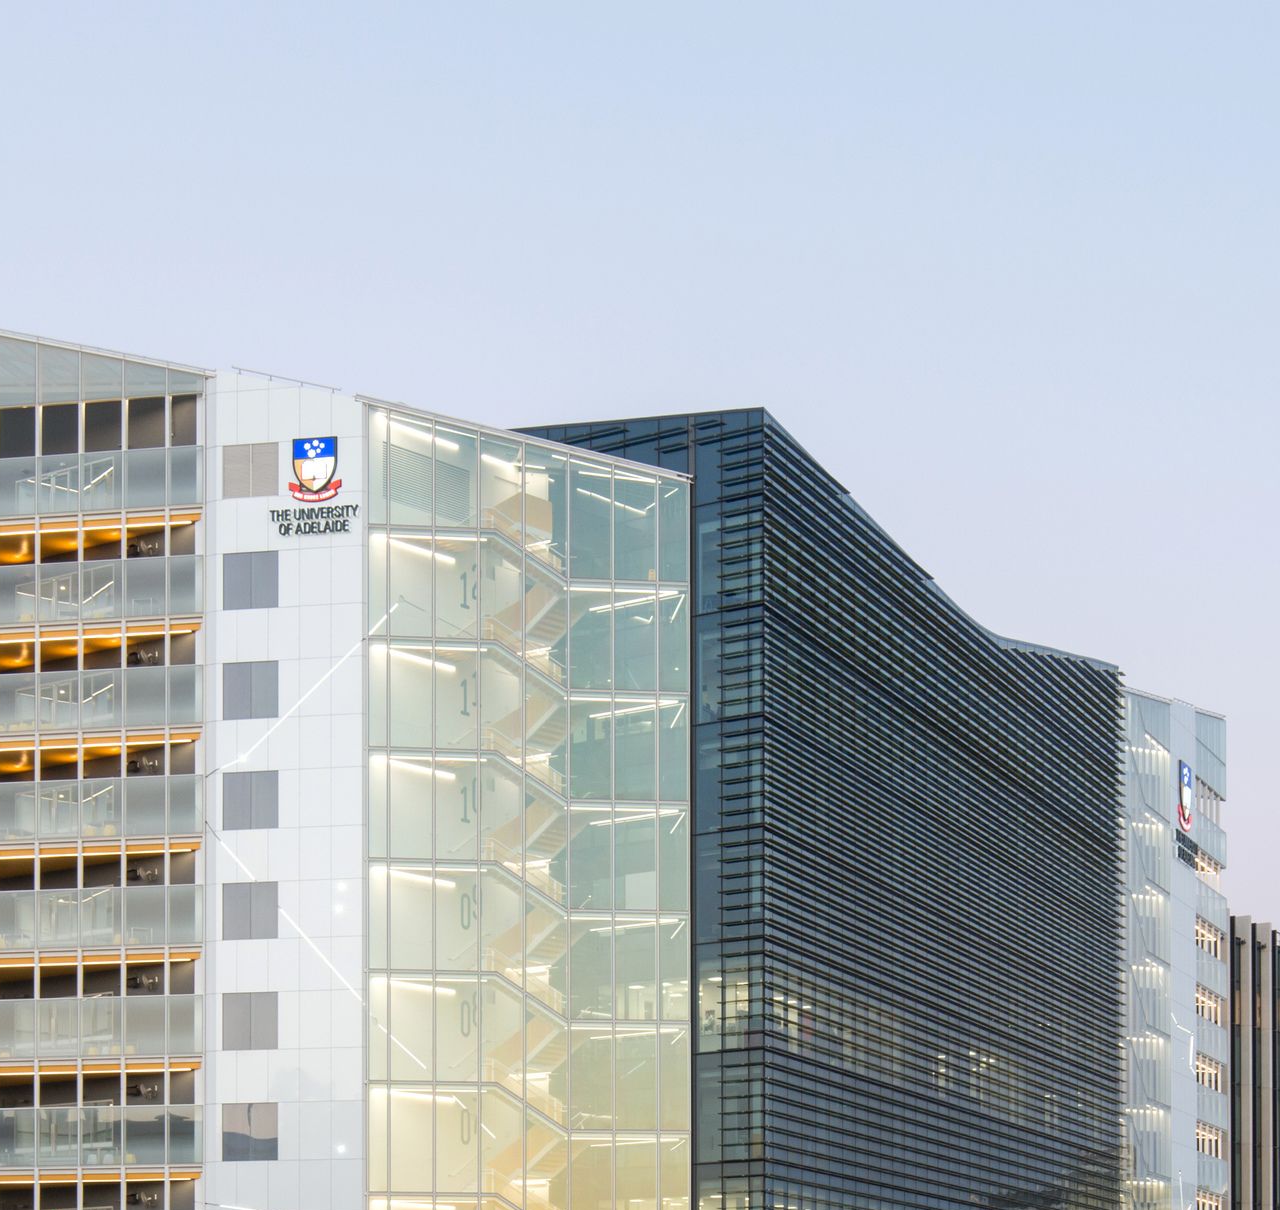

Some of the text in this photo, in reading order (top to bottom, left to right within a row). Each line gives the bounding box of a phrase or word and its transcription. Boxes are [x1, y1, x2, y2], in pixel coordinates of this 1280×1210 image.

[270, 505, 359, 522] THE UNIVERSITY
[279, 519, 350, 536] OF ADELAIDE
